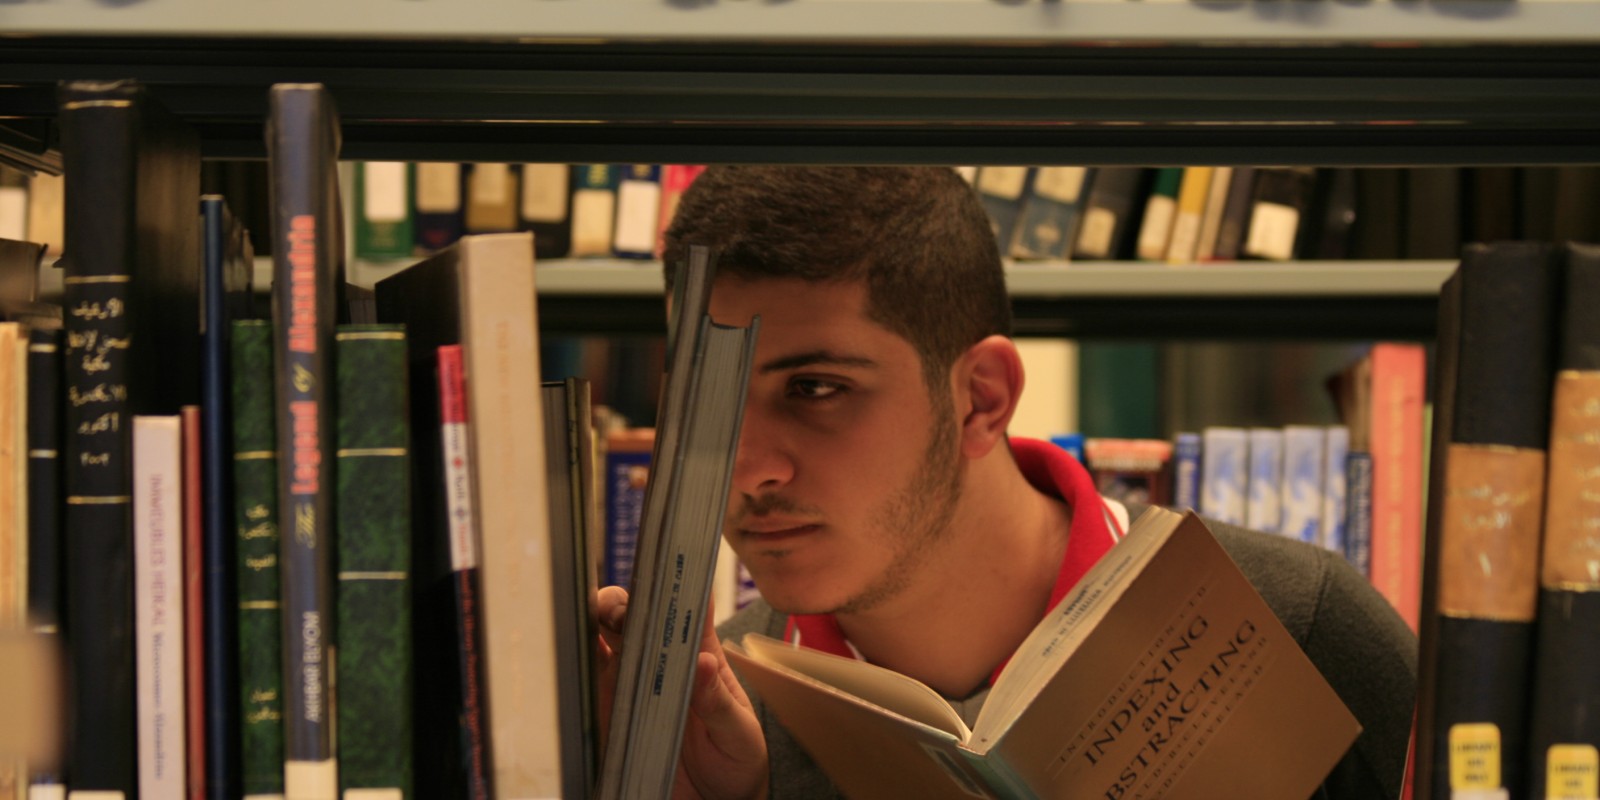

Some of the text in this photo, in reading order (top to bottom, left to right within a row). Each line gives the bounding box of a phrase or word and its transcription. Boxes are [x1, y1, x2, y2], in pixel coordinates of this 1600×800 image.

[287, 214, 317, 353] Alexandria
[290, 400, 321, 495] Legend
[294, 502, 317, 549] The
[1060, 625, 1175, 763] INTRODUCTION
[1189, 586, 1206, 608] TO
[1083, 615, 1209, 767] INDEXING
[1104, 620, 1256, 800] BSTRACTING
[1142, 681, 1181, 732] and
[1179, 664, 1264, 770] CLEVELAND
[1182, 636, 1267, 743] CLEVELAND
